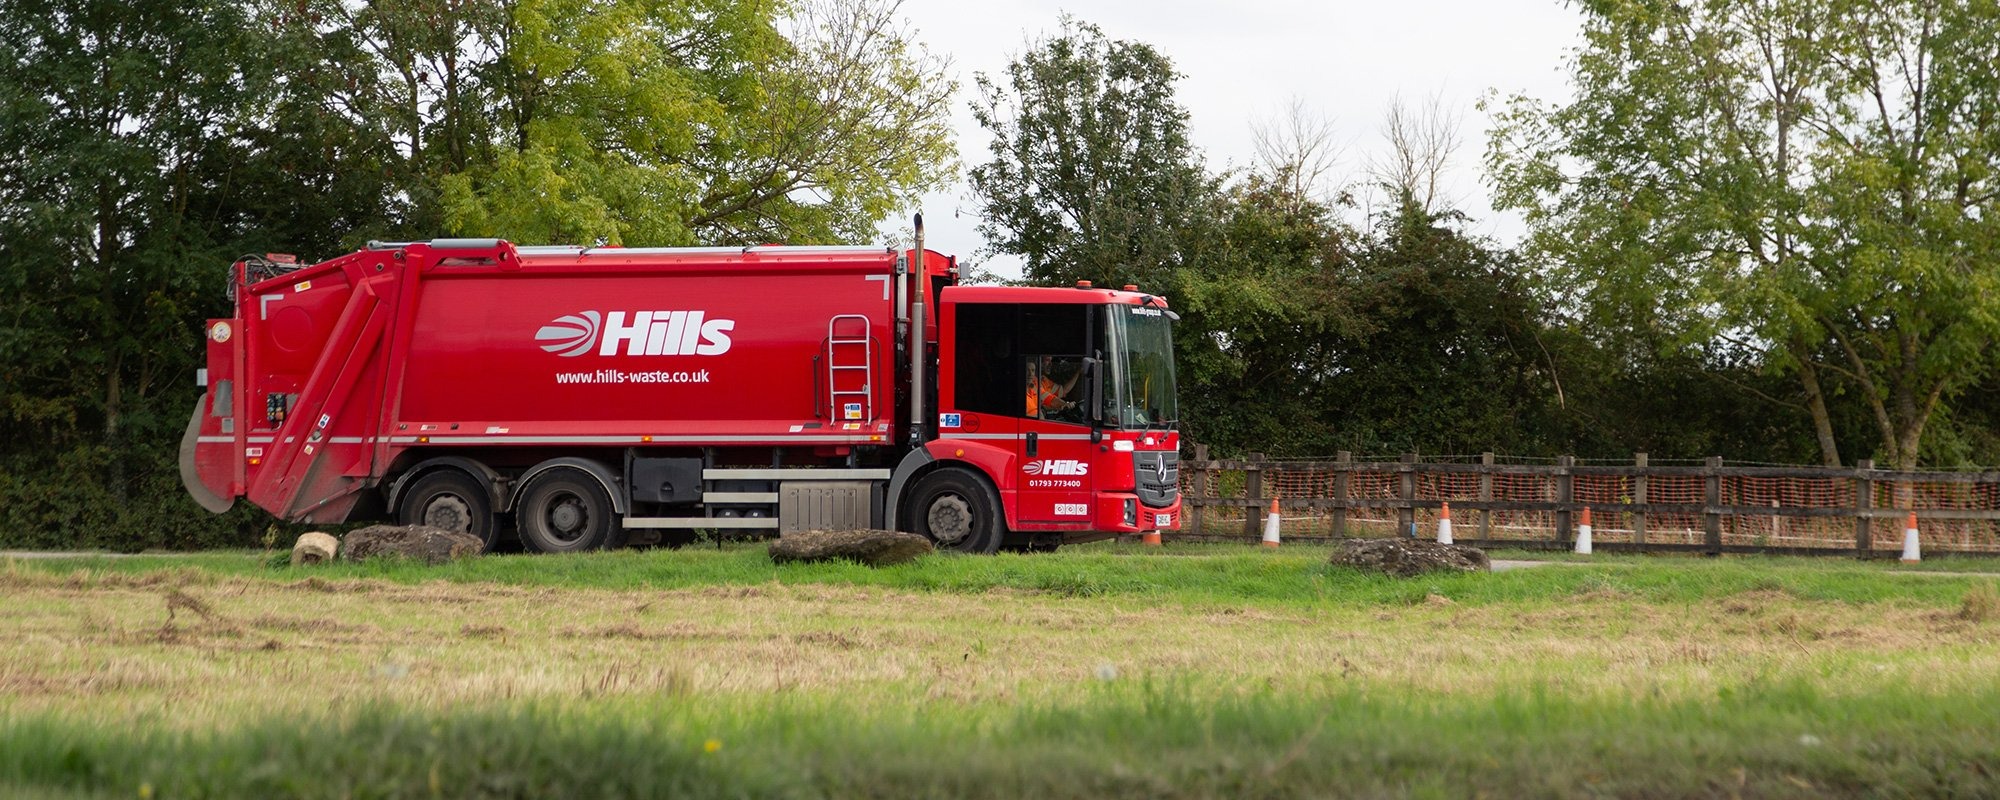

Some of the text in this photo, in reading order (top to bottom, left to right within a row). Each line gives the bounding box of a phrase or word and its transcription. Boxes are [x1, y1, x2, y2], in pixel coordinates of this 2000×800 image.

[599, 311, 735, 356] Hills
[556, 369, 710, 384] www.hills-waste.co.uk
[1042, 459, 1089, 476] Hills
[1029, 479, 1081, 487] 01793 773400
